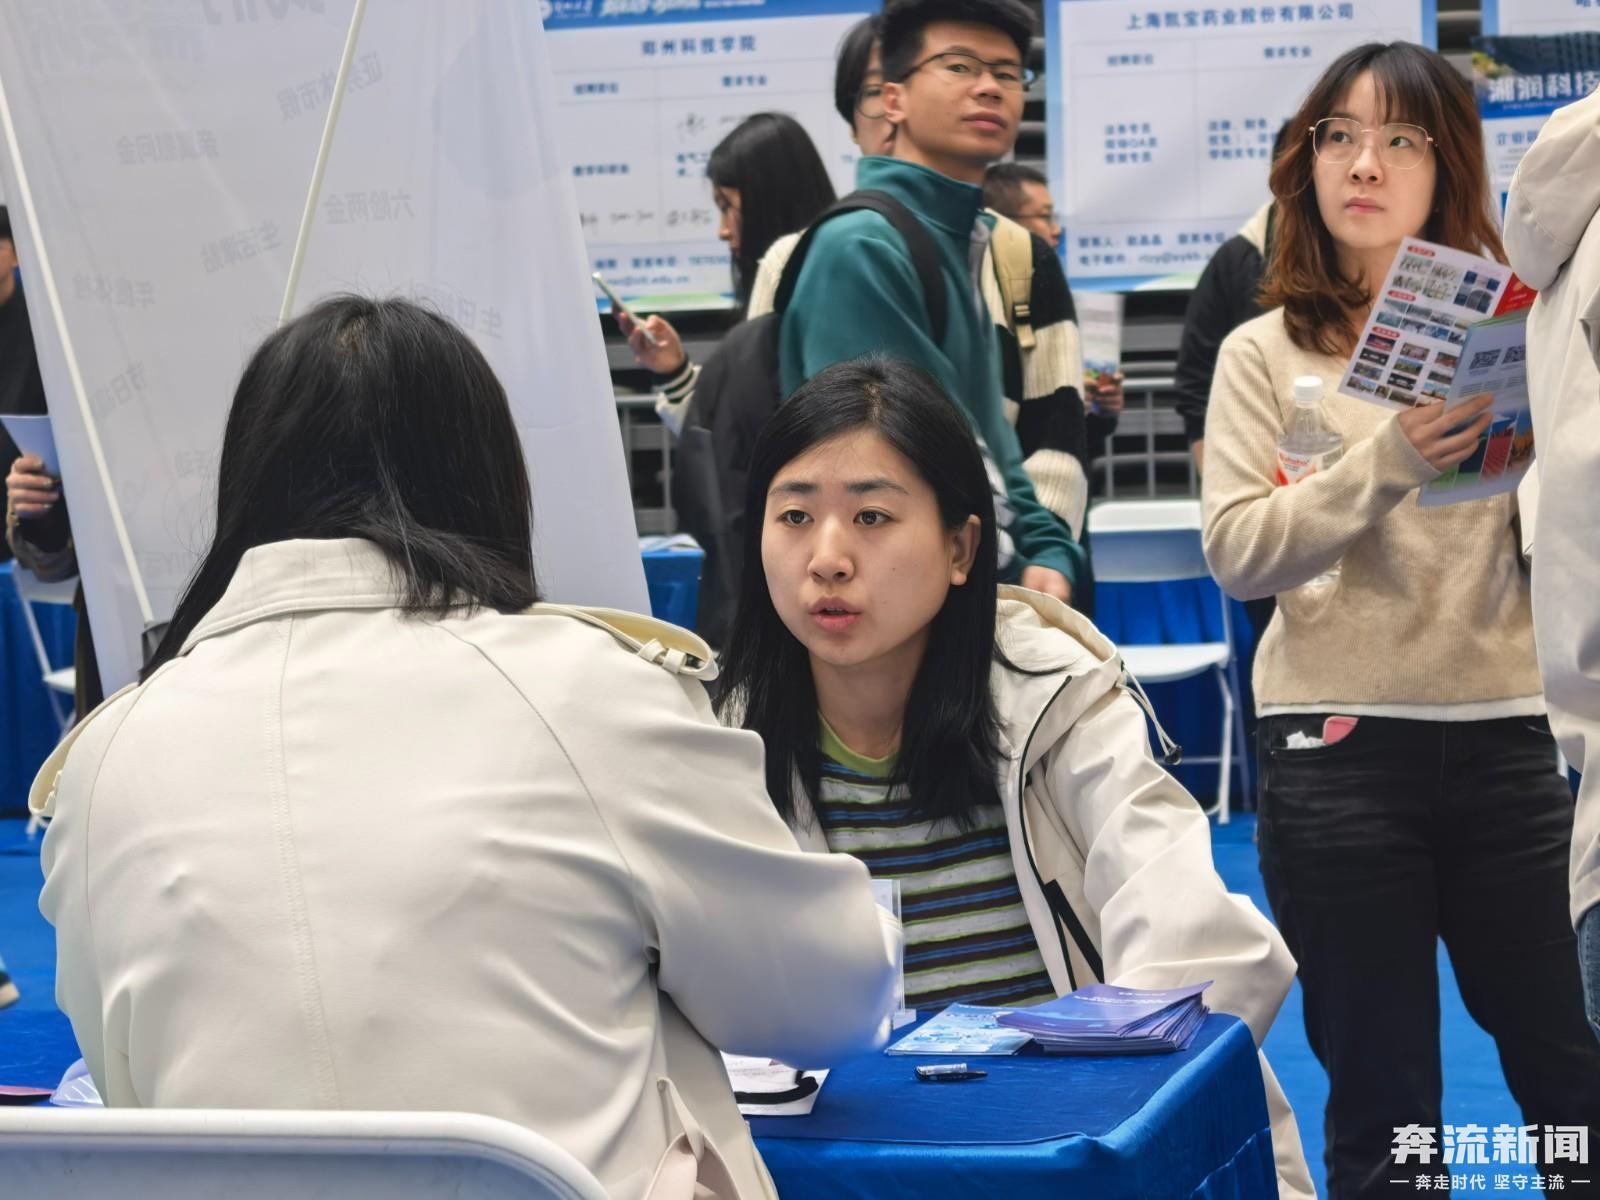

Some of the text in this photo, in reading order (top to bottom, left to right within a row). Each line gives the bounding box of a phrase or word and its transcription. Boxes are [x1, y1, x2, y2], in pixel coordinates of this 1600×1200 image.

[1127, 4, 1354, 30] 上海凯宝药业股份有限公司
[641, 35, 756, 55] 郑州科技学院
